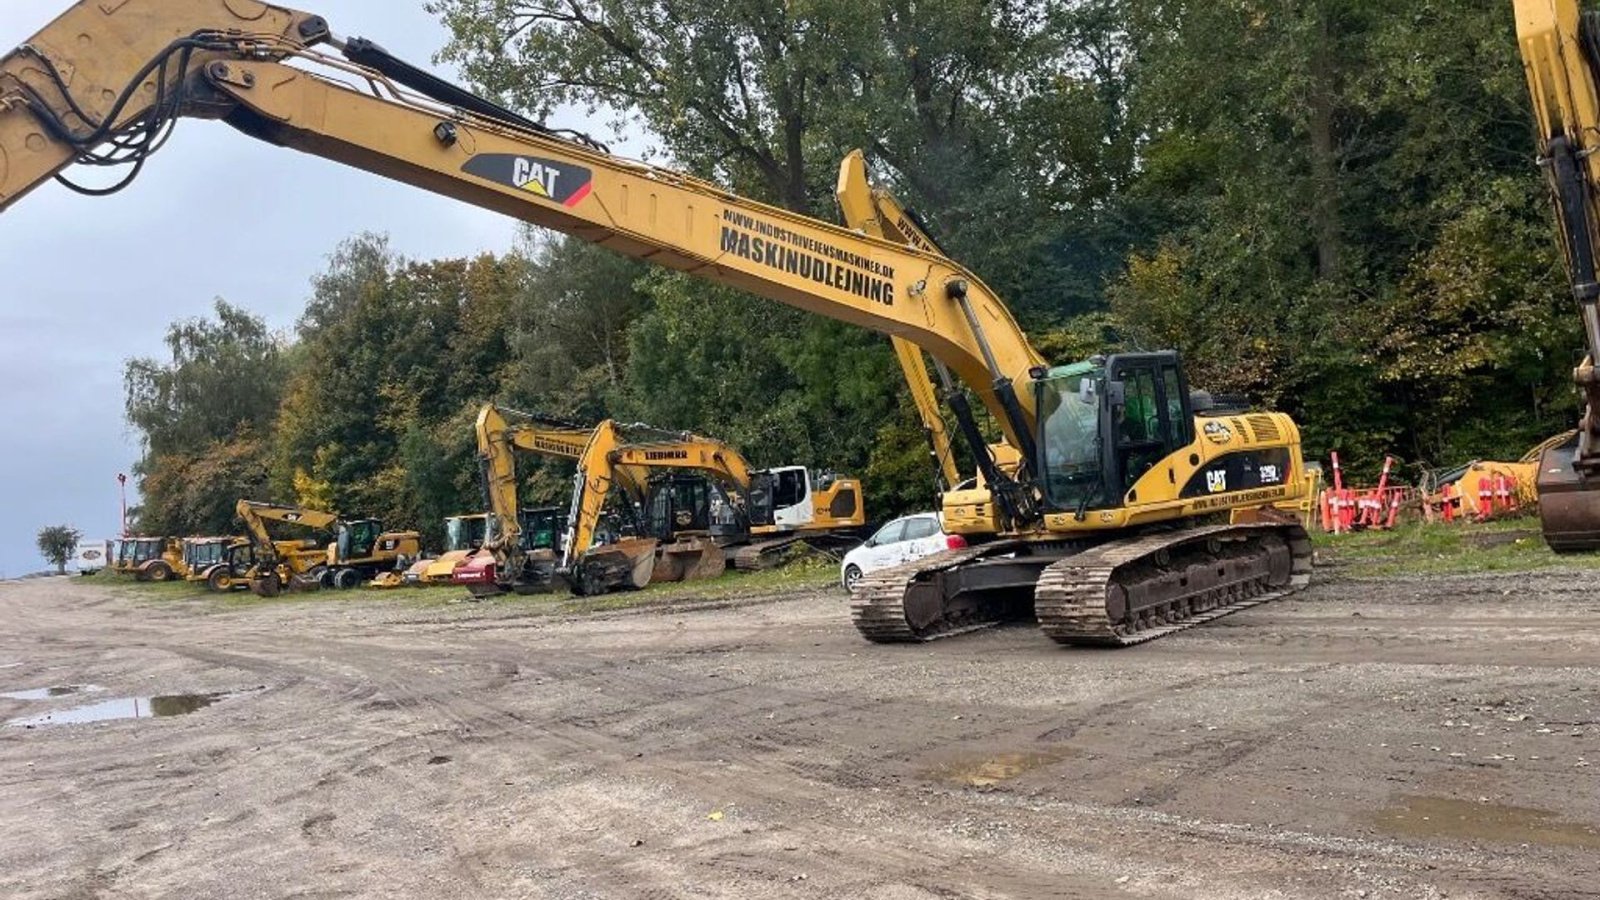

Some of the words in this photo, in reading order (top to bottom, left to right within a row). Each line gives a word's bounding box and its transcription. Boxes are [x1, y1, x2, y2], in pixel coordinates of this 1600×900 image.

[512, 157, 560, 198] CAT
[720, 226, 894, 306] MASKINUDLEJNING
[1206, 470, 1226, 492] CAT
